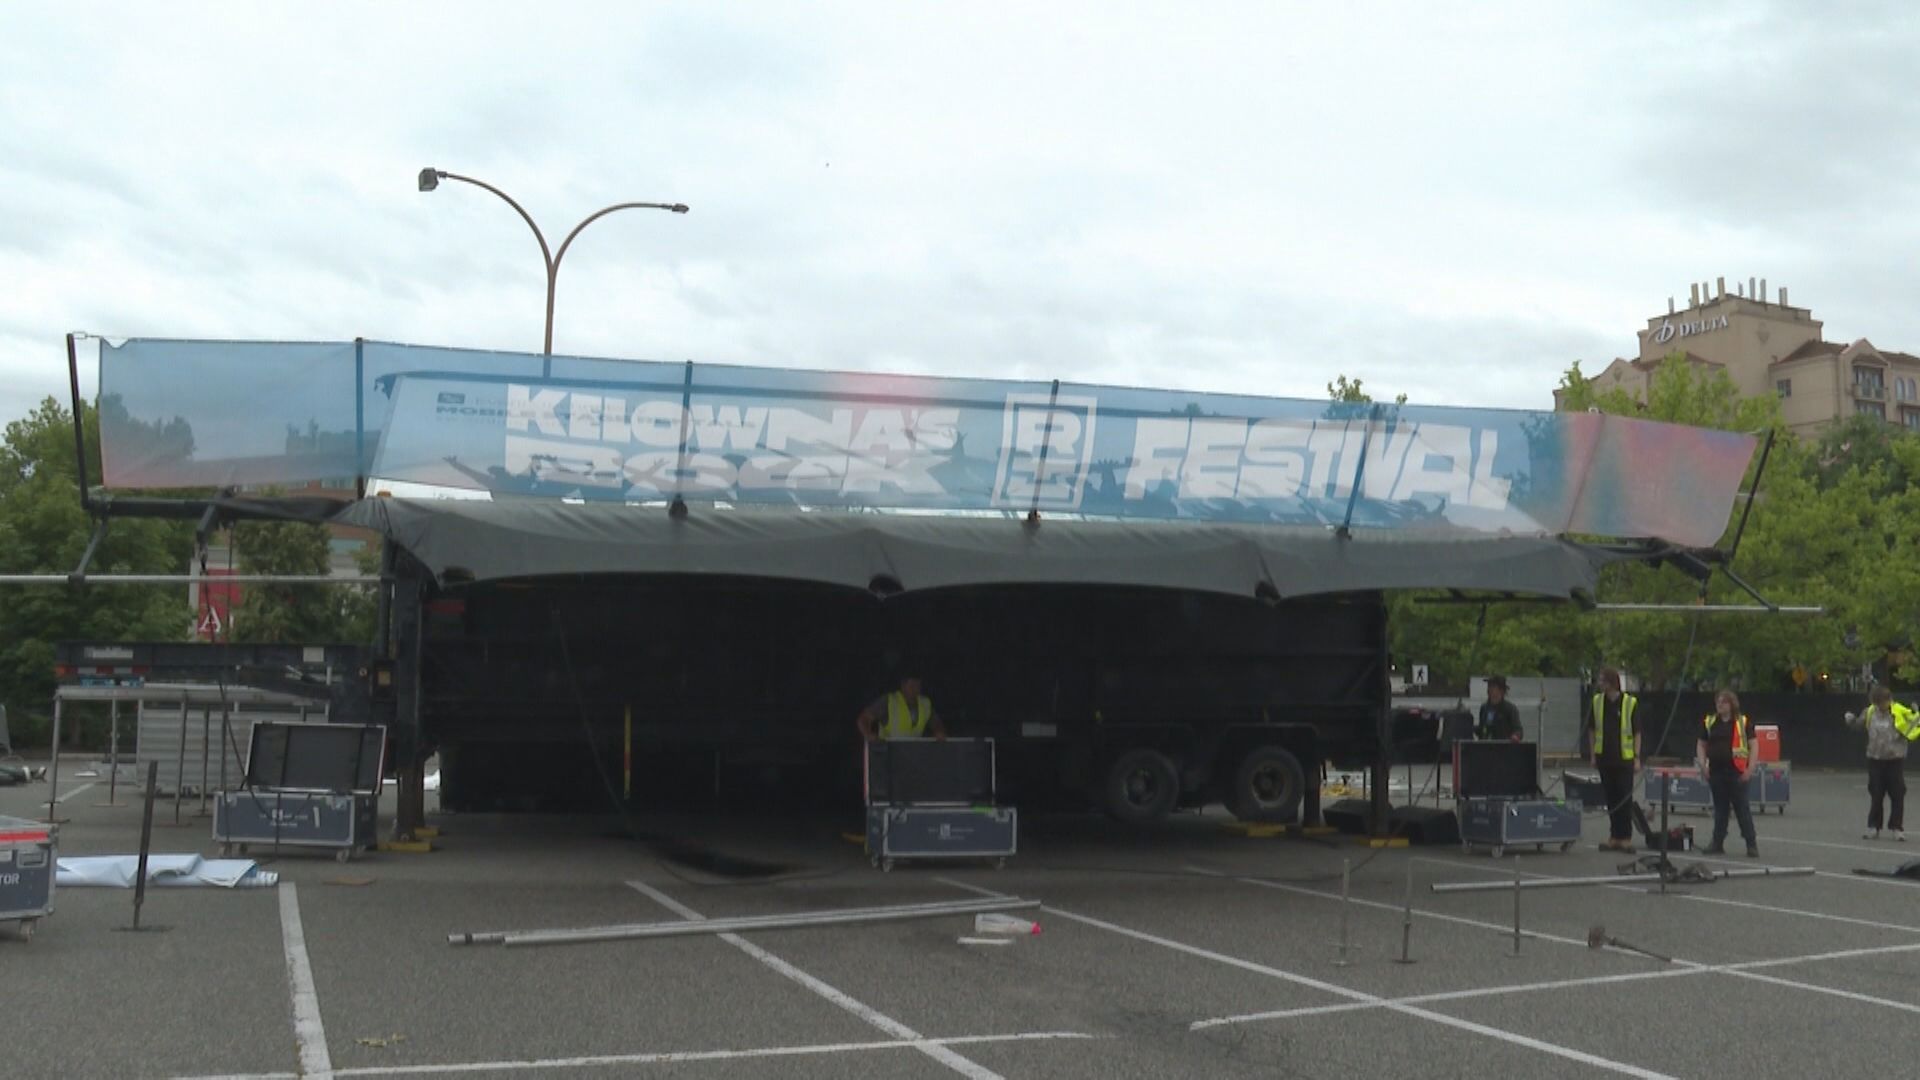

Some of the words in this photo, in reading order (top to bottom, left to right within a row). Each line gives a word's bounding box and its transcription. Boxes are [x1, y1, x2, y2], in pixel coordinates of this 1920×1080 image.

[1680, 314, 1728, 337] DELTA
[506, 384, 959, 453] KELOWNA'S
[1123, 417, 1512, 510] FESTIVAL
